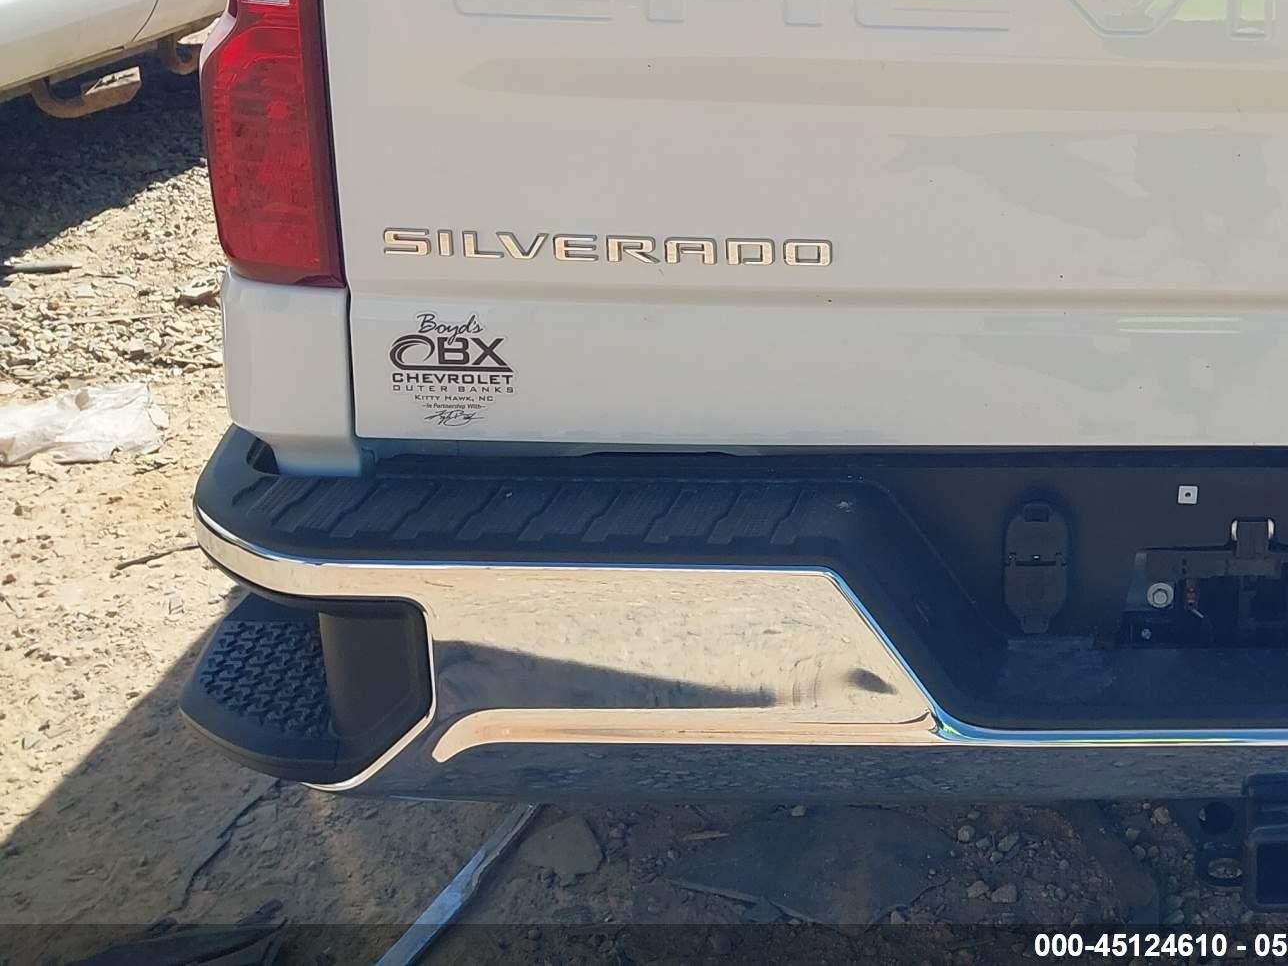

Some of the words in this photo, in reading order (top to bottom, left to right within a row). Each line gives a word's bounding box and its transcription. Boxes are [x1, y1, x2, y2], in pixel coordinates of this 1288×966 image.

[383, 227, 834, 267] SILVERADO
[416, 313, 483, 346] Boyd's
[389, 334, 513, 373] OBX
[392, 372, 513, 385] CHEVROLET
[392, 384, 448, 392] OUTER
[458, 386, 514, 394] BANKS
